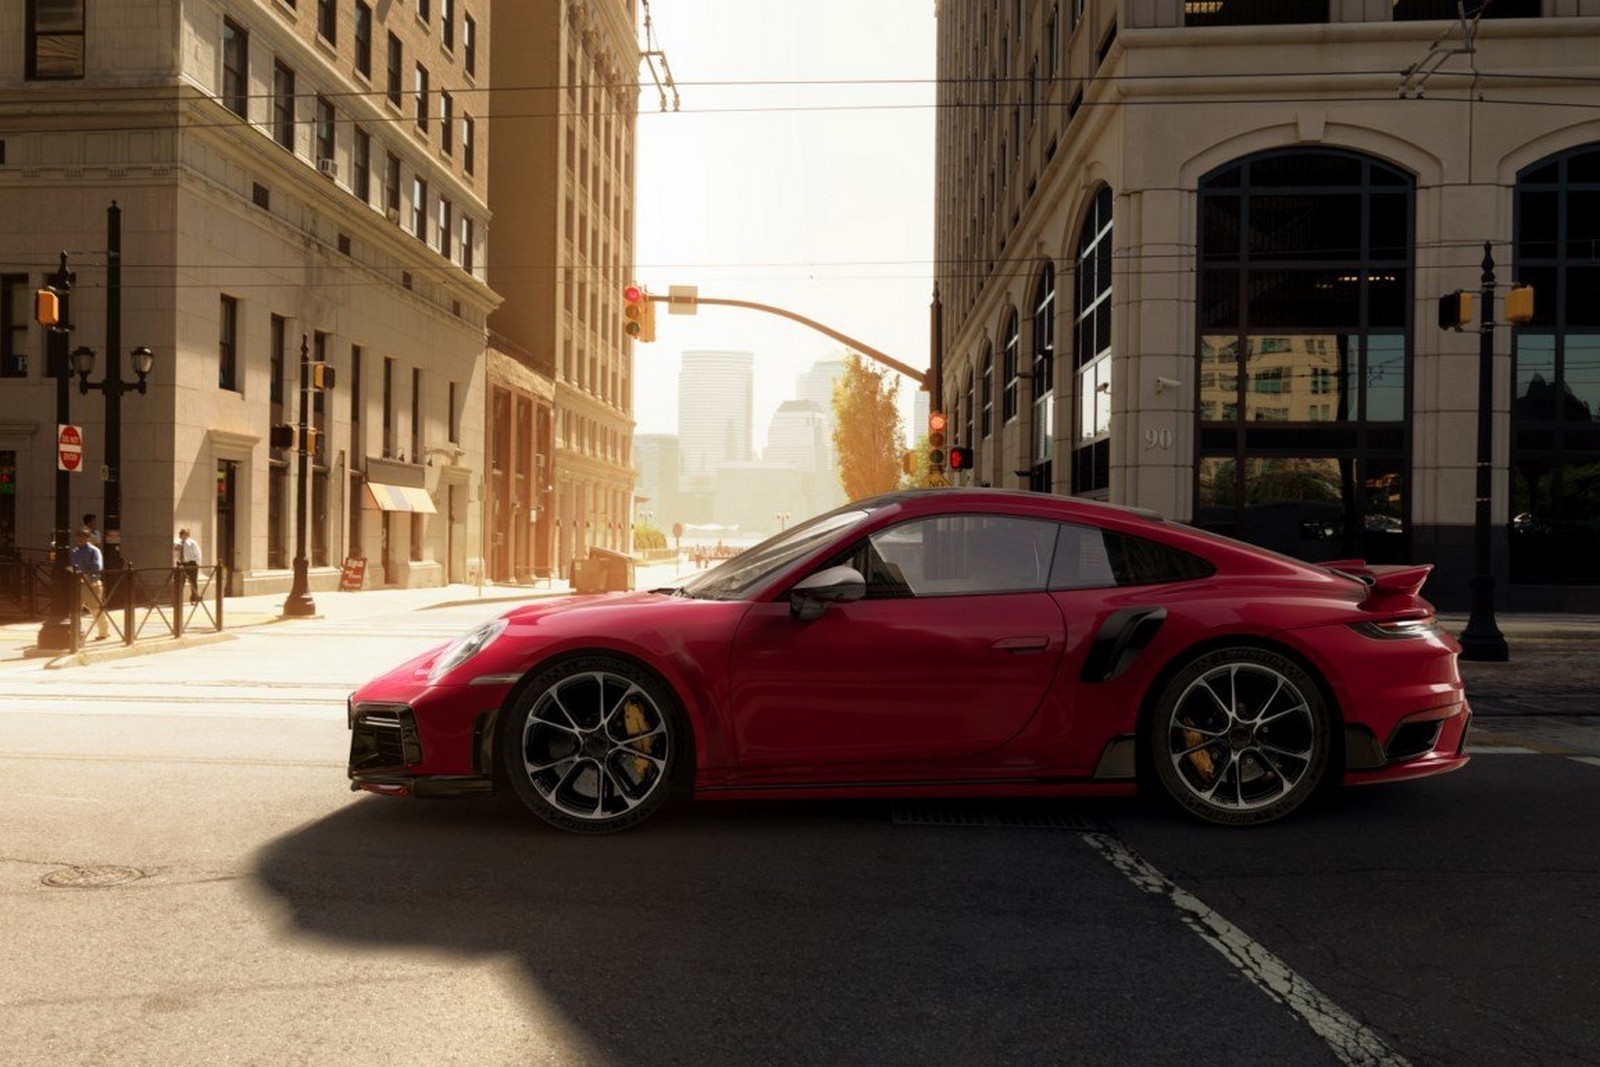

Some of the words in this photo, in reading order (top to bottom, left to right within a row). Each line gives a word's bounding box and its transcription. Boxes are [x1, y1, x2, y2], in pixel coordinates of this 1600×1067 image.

[62, 435, 70, 444] DO
[70, 436, 80, 445] NOT
[1145, 428, 1172, 451] 90
